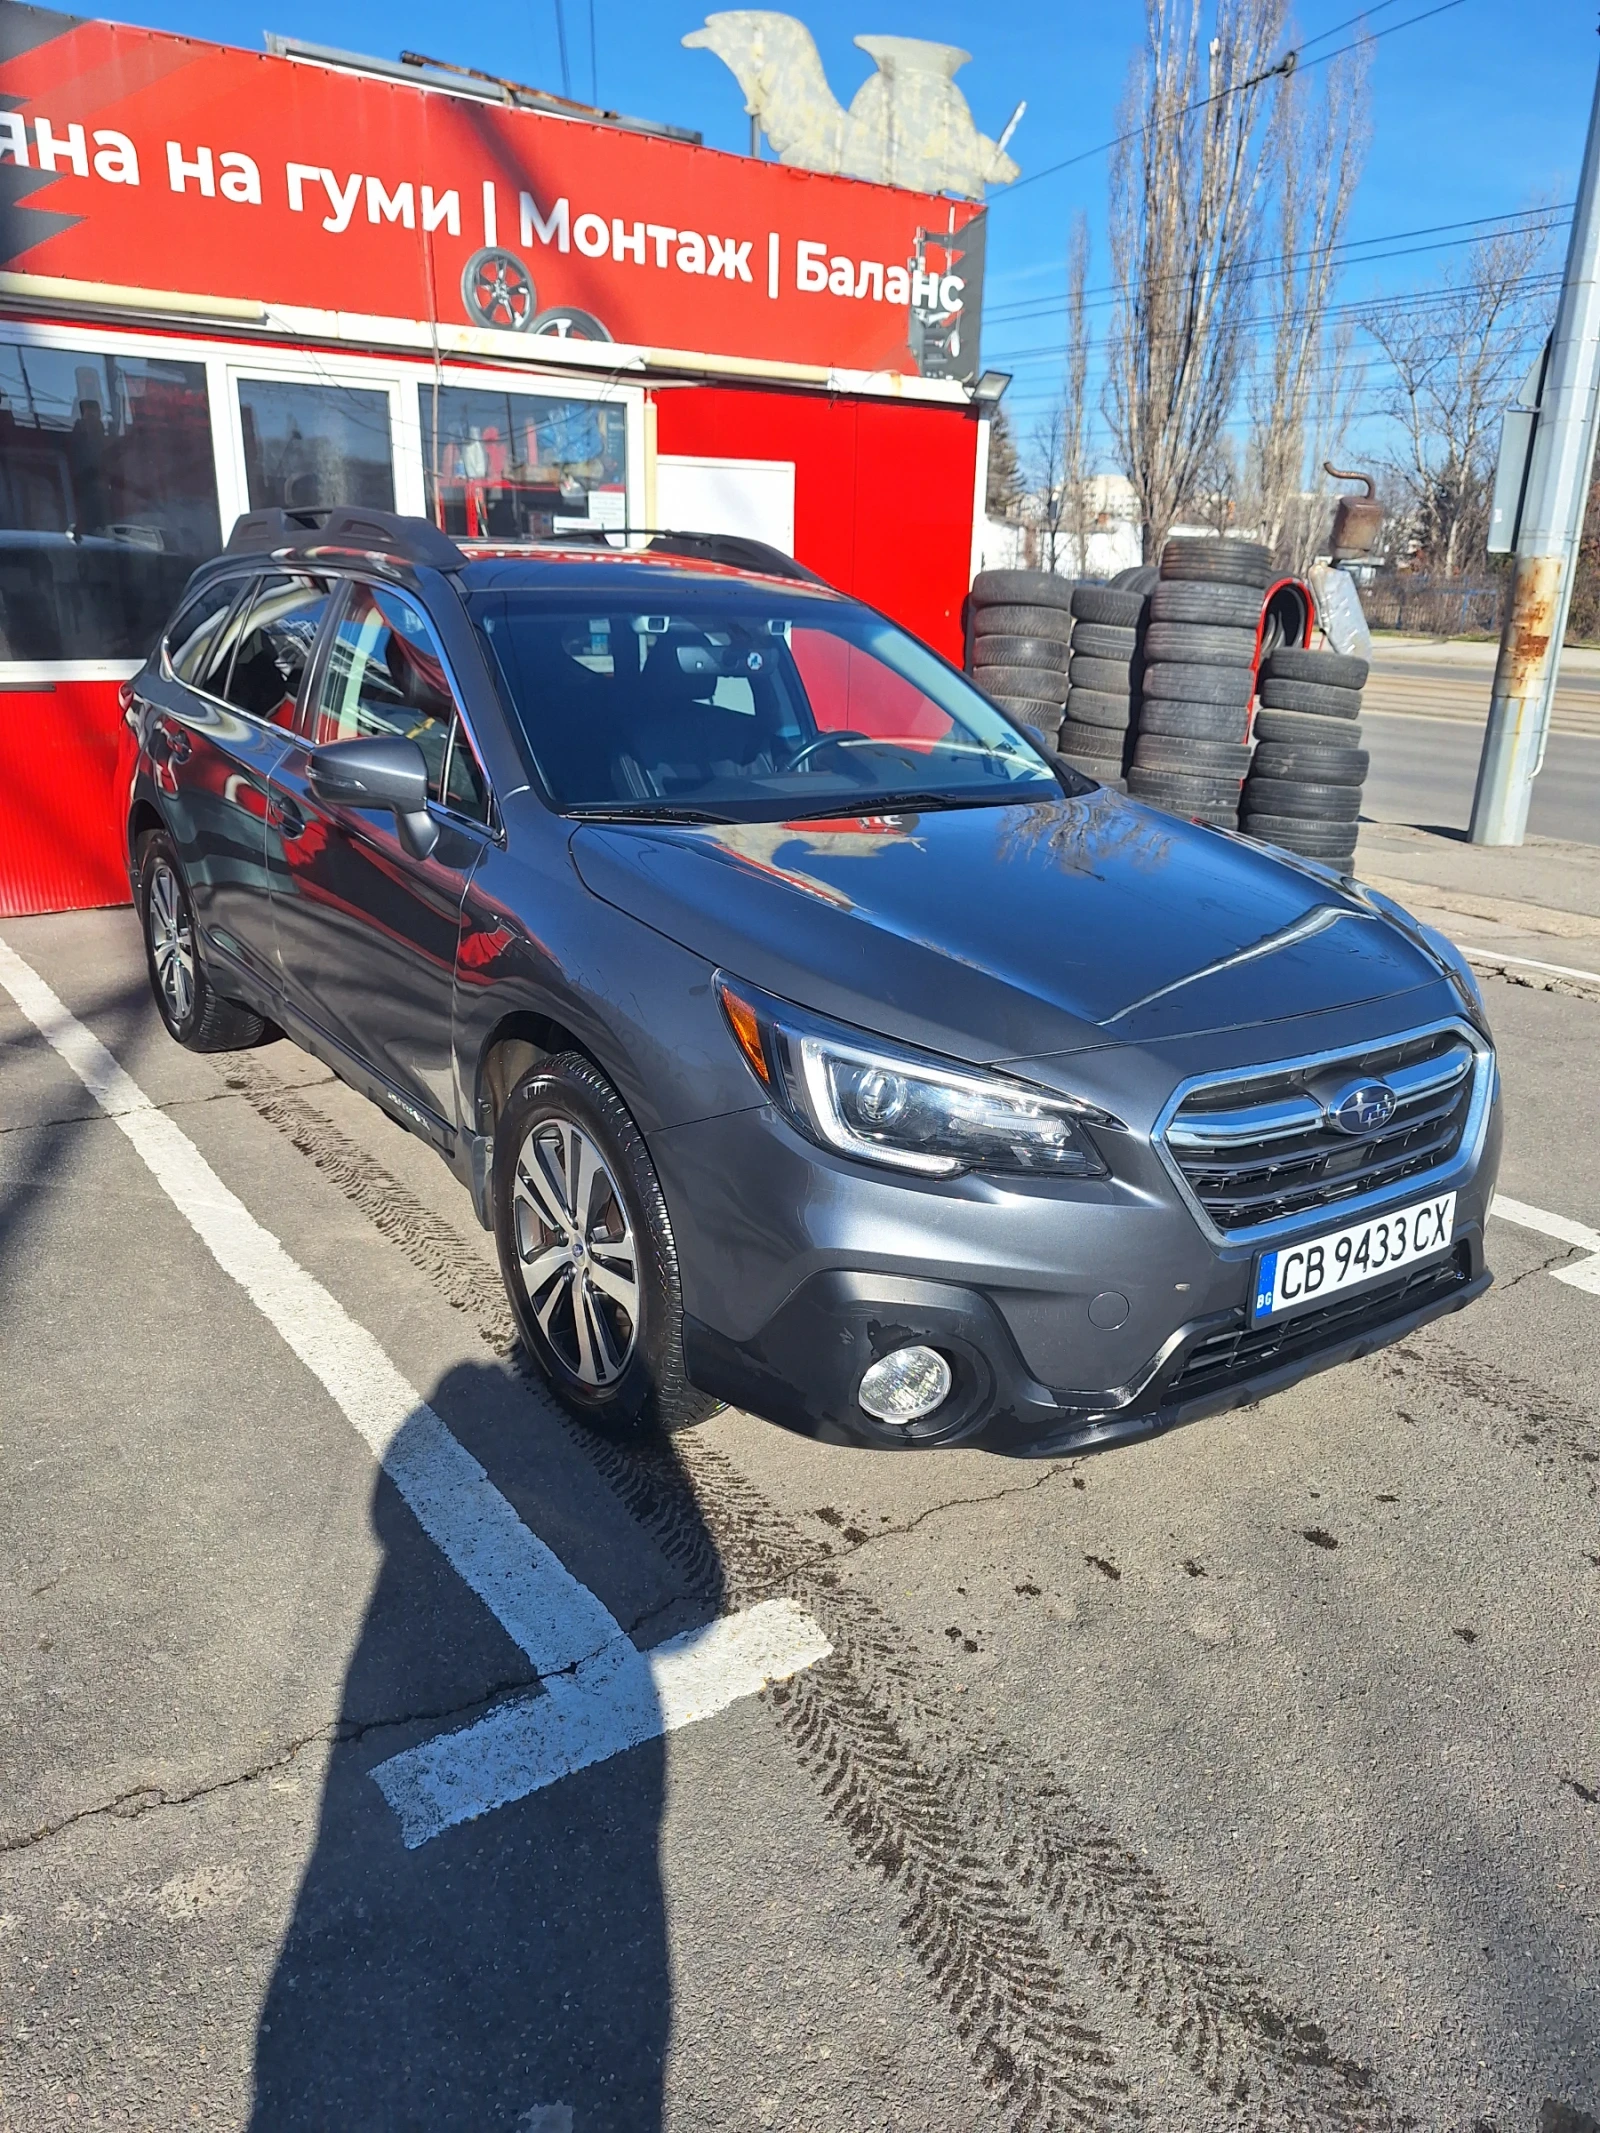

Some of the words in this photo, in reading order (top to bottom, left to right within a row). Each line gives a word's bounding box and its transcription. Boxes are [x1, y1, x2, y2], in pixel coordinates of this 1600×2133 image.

[166, 141, 262, 204] на
[286, 162, 460, 233] гуми
[520, 192, 753, 282] Монтаж
[797, 240, 966, 312] Баланс
[1281, 1247, 1325, 1299] CB
[1335, 1218, 1406, 1282] 9433
[1414, 1199, 1450, 1251] CX
[1257, 1292, 1272, 1309] BG
